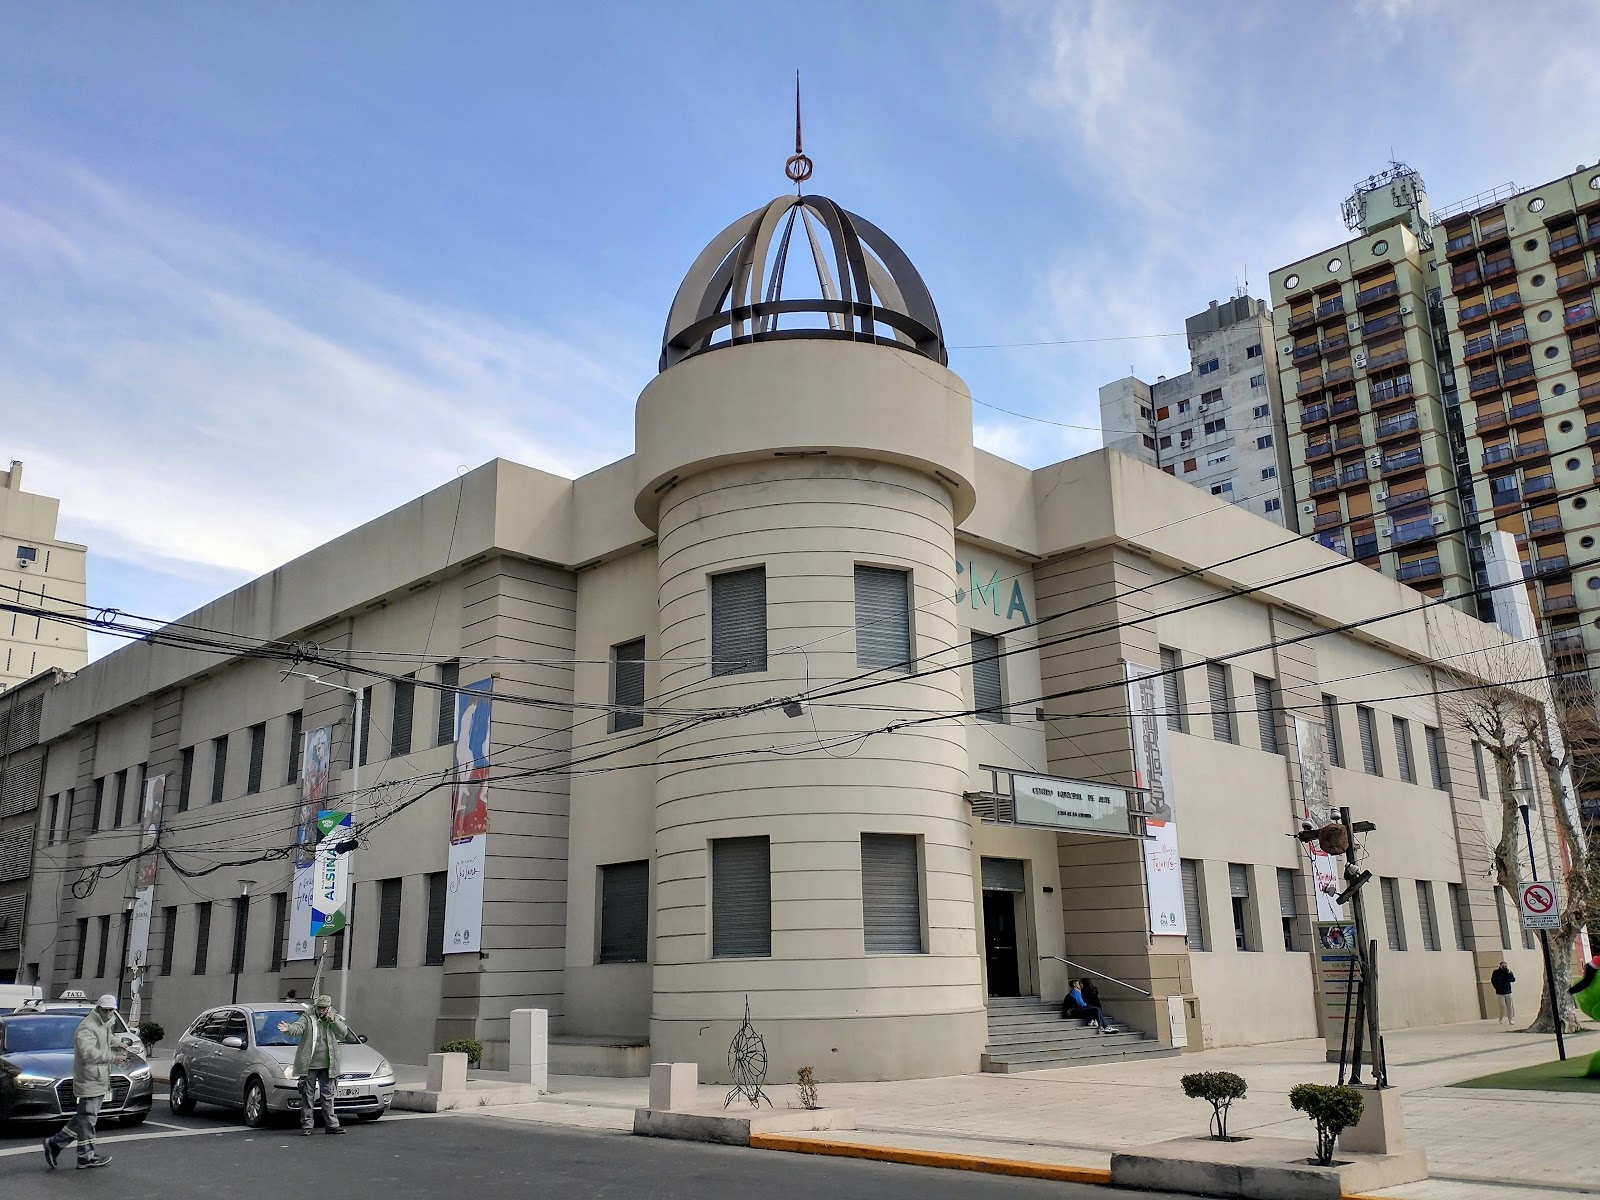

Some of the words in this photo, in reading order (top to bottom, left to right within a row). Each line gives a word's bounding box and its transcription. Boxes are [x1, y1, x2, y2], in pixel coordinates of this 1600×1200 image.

[1032, 787, 1053, 797] CENTRO
[1057, 790, 1083, 801] MUNICIPAL
[1087, 794, 1095, 802] DE
[1098, 796, 1111, 804] ARTE
[324, 847, 337, 901] ALSINA
